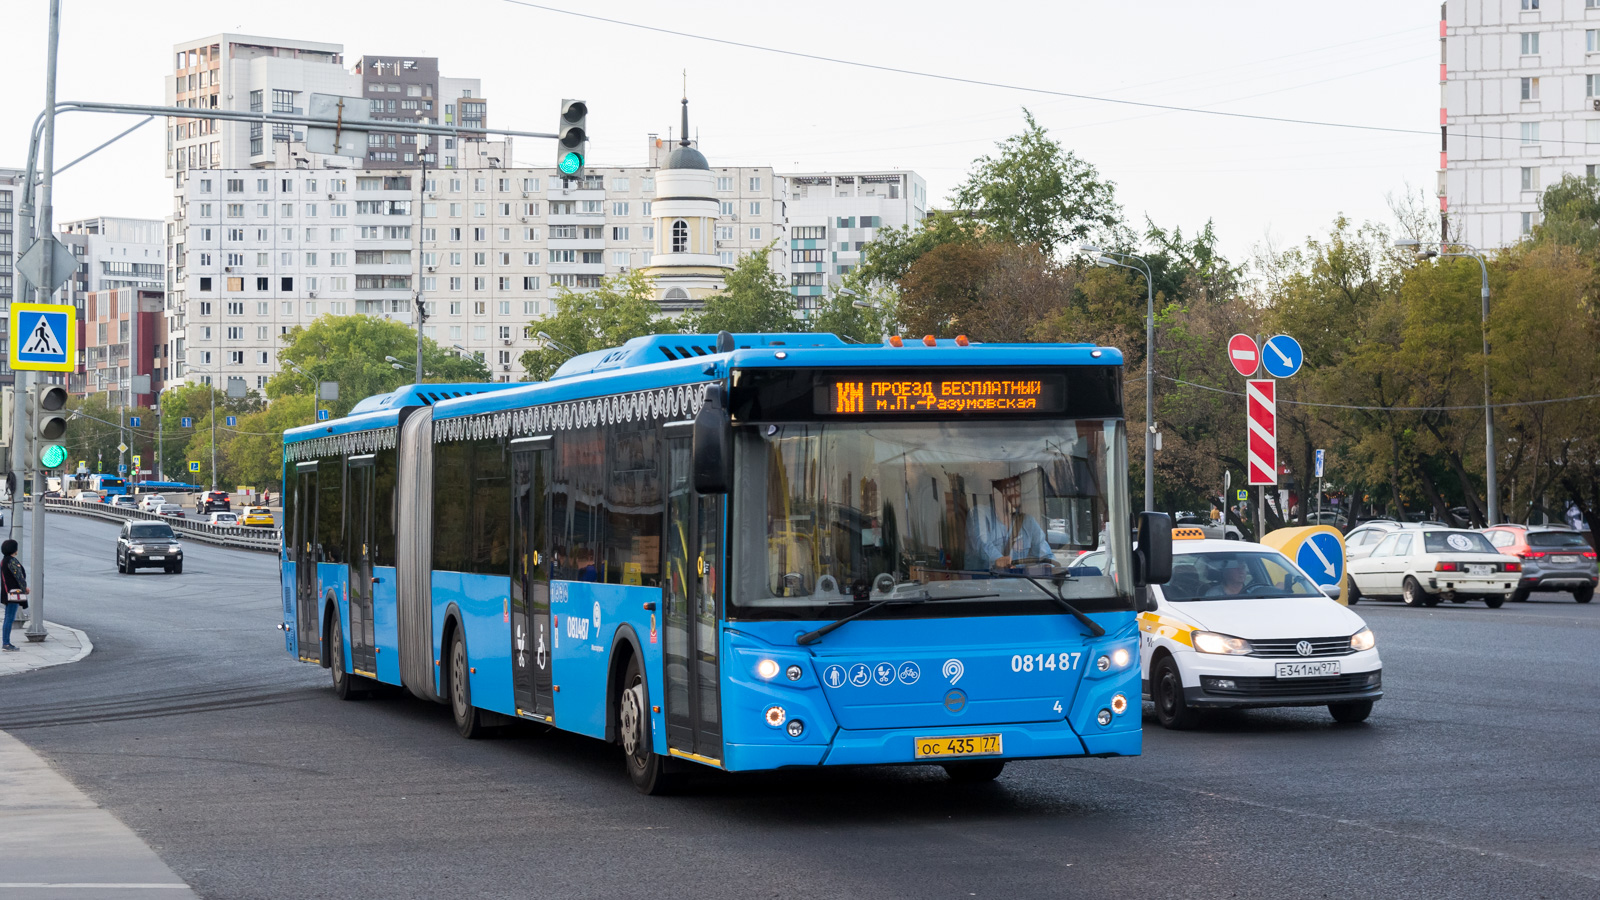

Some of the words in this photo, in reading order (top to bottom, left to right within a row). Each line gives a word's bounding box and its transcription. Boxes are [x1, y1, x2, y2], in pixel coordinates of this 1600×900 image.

[871, 382, 934, 397] ПРОЕЗД
[941, 380, 1041, 395] БЕСПЛАТНЫЙ
[836, 382, 864, 413] КМ
[876, 394, 1037, 411] м.П.-Разумовская
[567, 616, 589, 640] 081487
[1011, 652, 1082, 673] 081487
[1321, 663, 1337, 672] 977
[1053, 700, 1063, 714] 4
[922, 743, 940, 755] ОС
[947, 739, 974, 754] 435
[982, 737, 996, 748] 77
